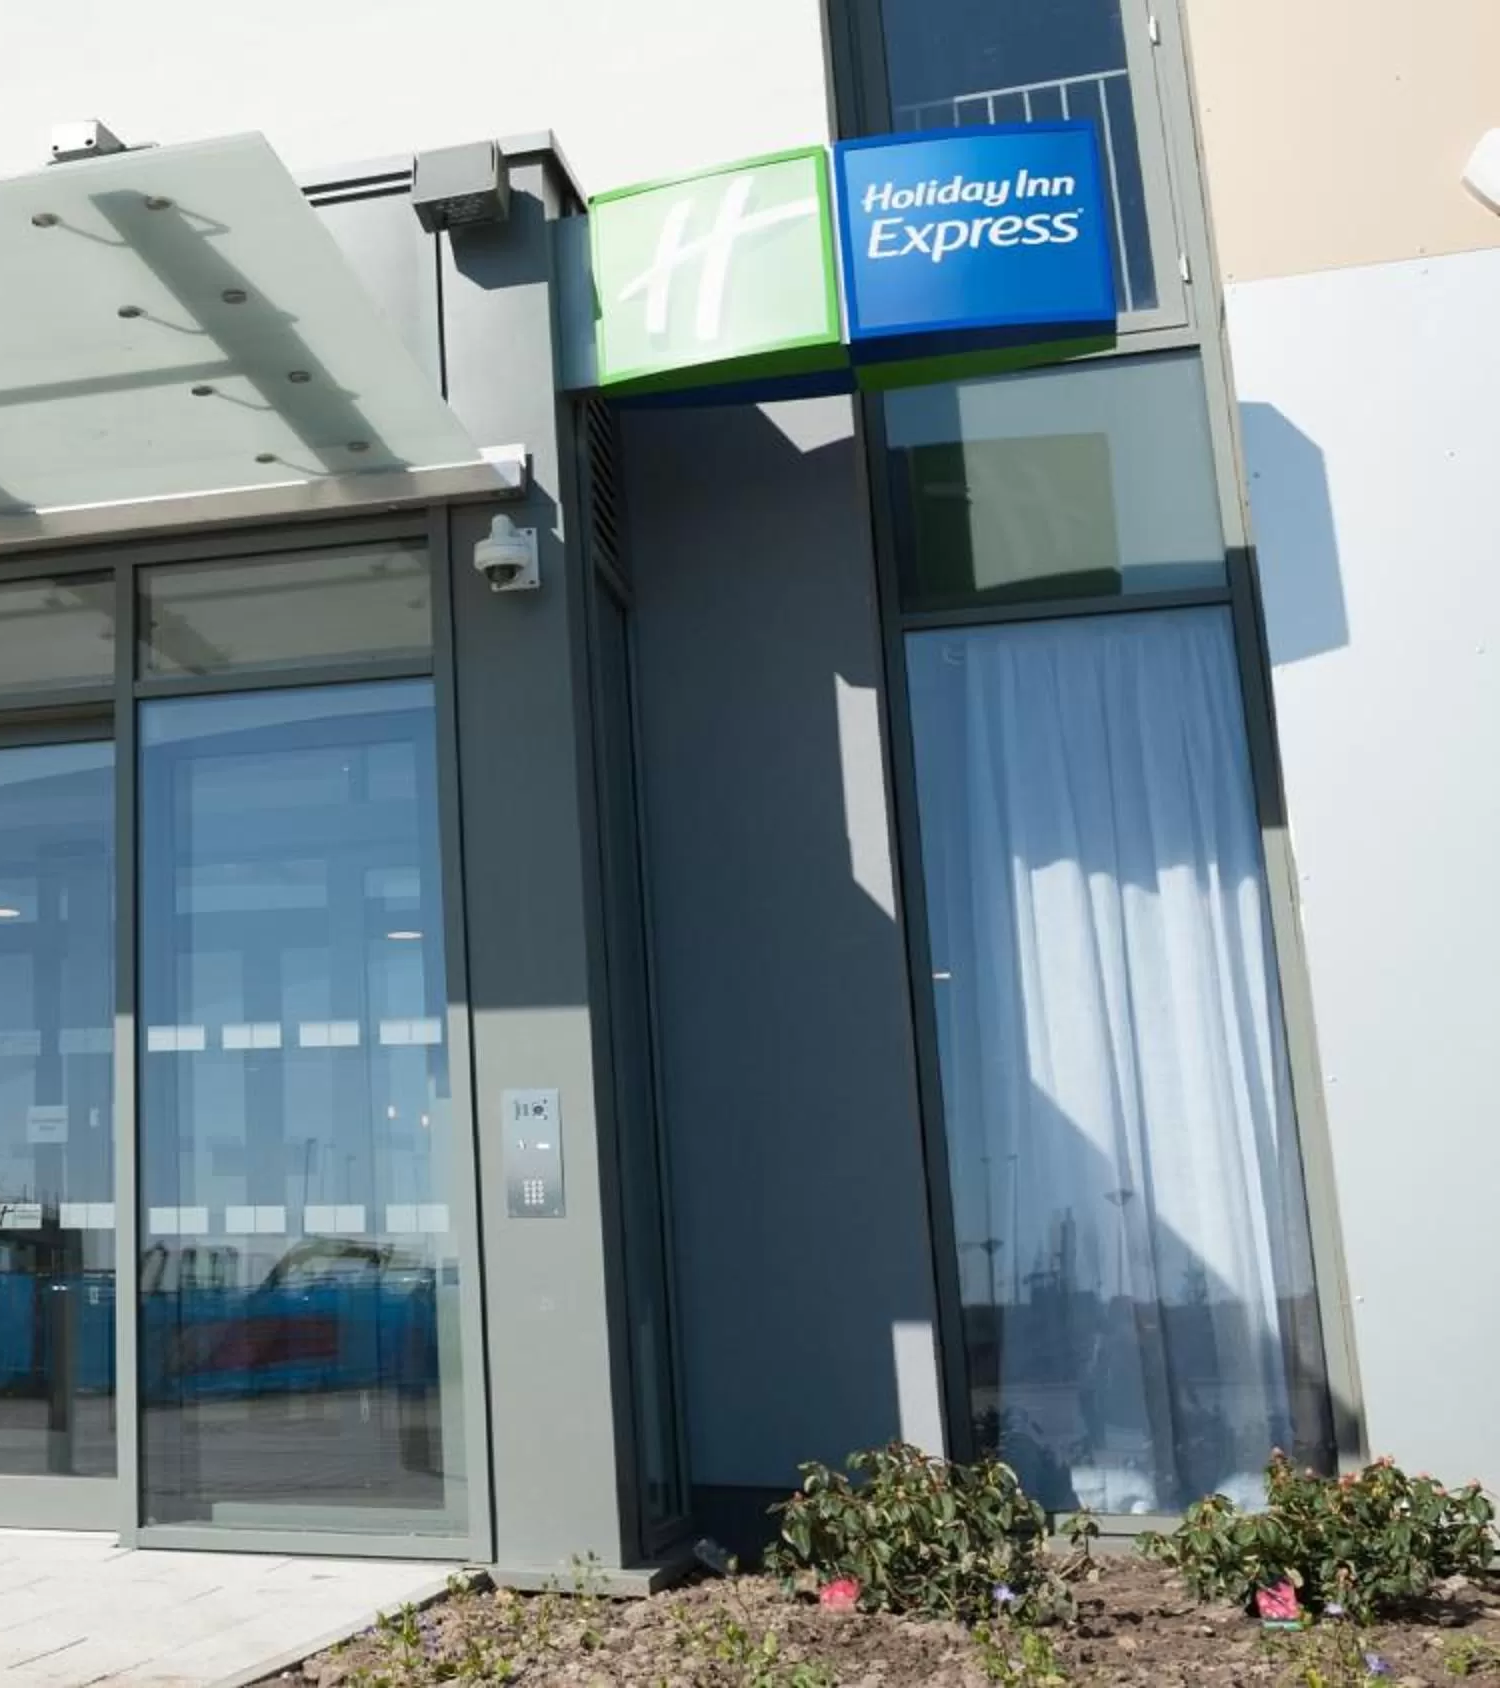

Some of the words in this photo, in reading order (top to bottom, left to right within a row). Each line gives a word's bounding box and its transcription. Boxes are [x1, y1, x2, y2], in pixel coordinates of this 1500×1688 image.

[862, 175, 1010, 213] Holiday
[1015, 169, 1075, 198] Inn
[868, 211, 1079, 263] Express
